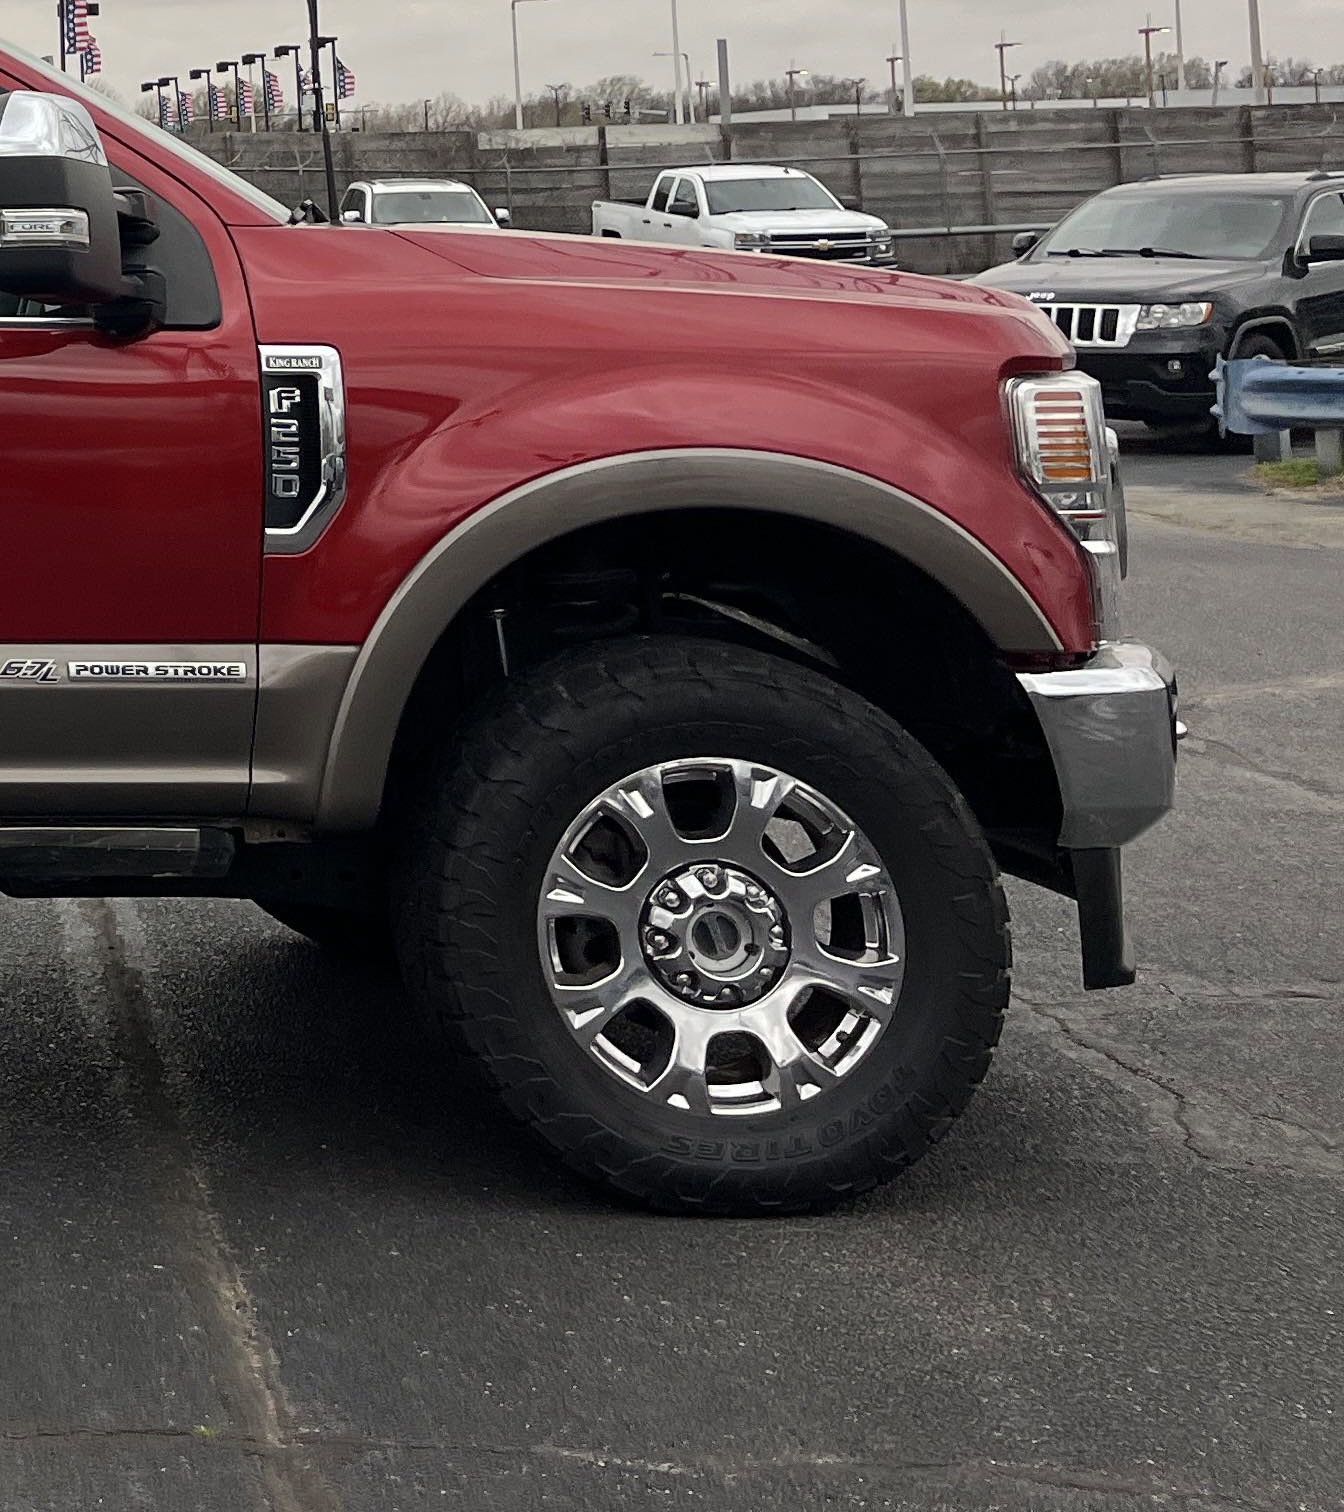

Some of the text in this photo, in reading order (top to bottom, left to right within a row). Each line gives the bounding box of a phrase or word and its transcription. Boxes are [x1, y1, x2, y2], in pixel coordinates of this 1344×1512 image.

[269, 357, 291, 368] KING
[75, 664, 241, 677] POWER STROKE
[662, 1134, 815, 1163] TIRES
